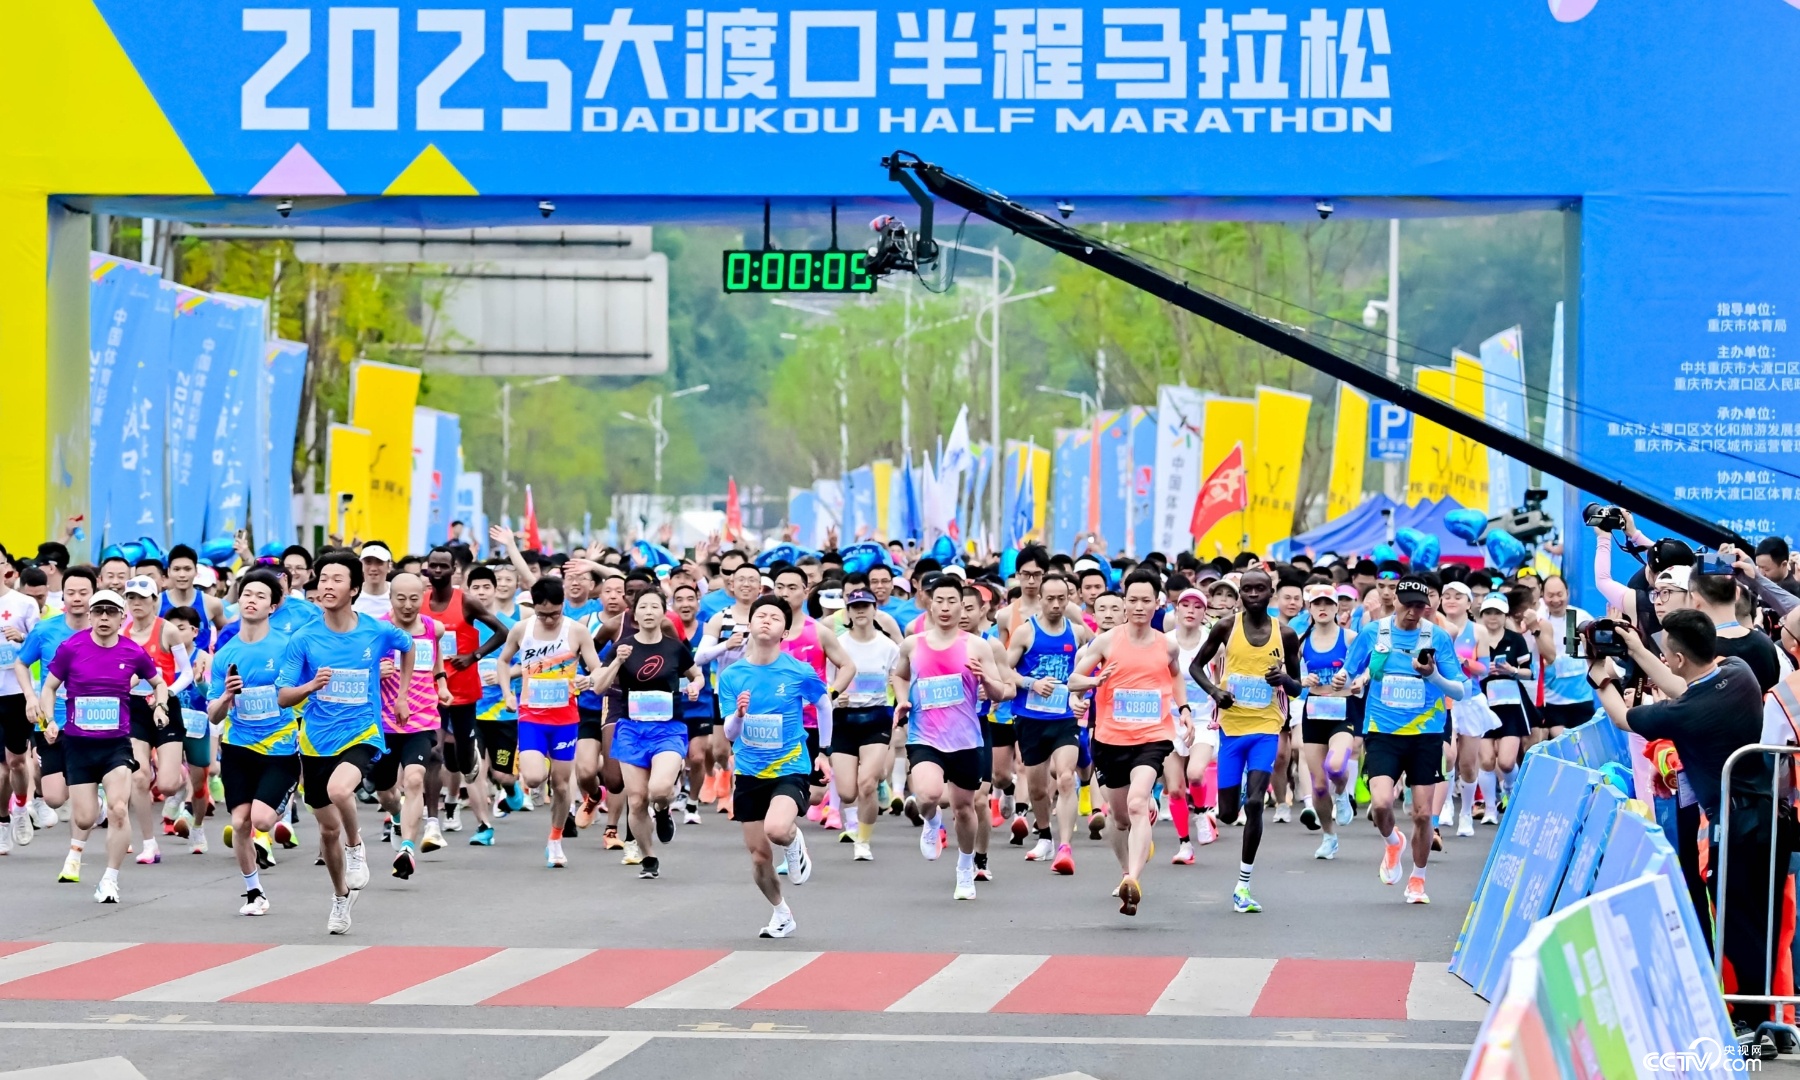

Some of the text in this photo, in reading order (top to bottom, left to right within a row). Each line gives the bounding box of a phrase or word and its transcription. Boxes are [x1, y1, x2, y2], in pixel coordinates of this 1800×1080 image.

[242, 8, 1392, 131] 2025 大渡口半程马拉松
[583, 107, 1392, 132] DADUKOU HALF MARATHON
[727, 253, 872, 290] 0:00:05
[1707, 319, 1787, 333] 重庆市体育局
[1381, 405, 1407, 439] P
[332, 680, 365, 694] 05333
[540, 688, 565, 700] 12270
[933, 685, 959, 699] 12193
[1241, 686, 1267, 700] 12156
[1393, 687, 1423, 700] 00055
[244, 698, 273, 711] 03071
[87, 708, 117, 720] 00000
[746, 726, 778, 739] 00024
